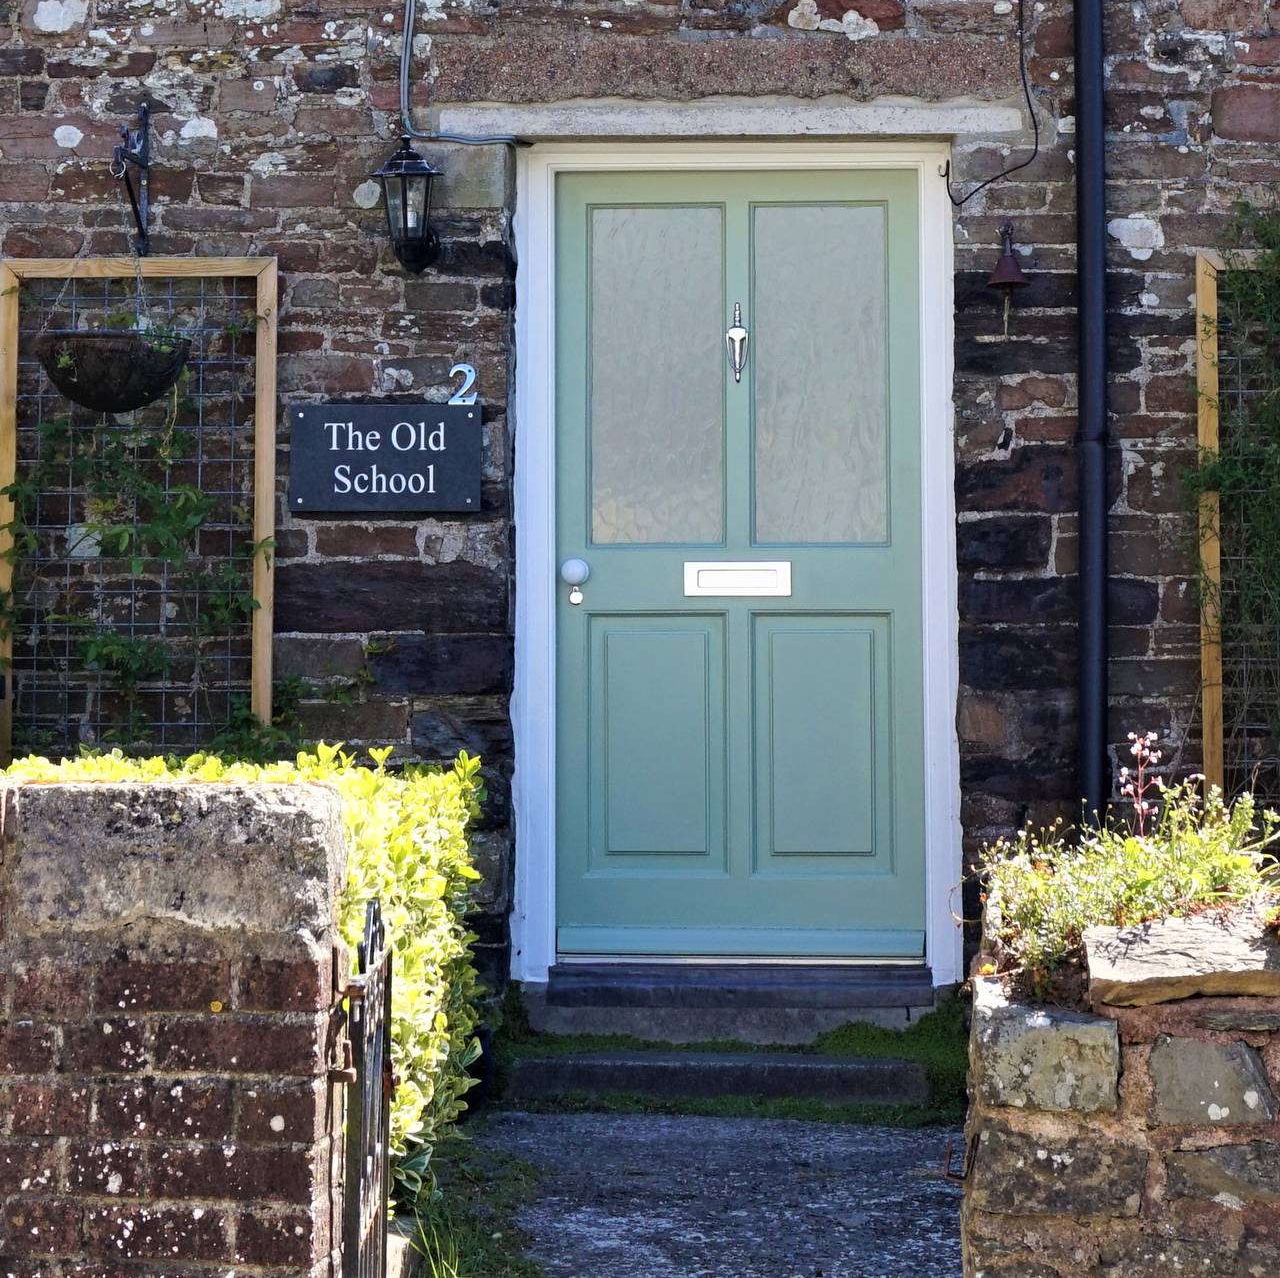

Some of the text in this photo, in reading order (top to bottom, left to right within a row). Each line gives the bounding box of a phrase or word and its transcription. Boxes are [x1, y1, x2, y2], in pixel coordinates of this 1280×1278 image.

[447, 363, 478, 406] 2
[323, 421, 447, 451] The Old
[333, 464, 436, 494] School
